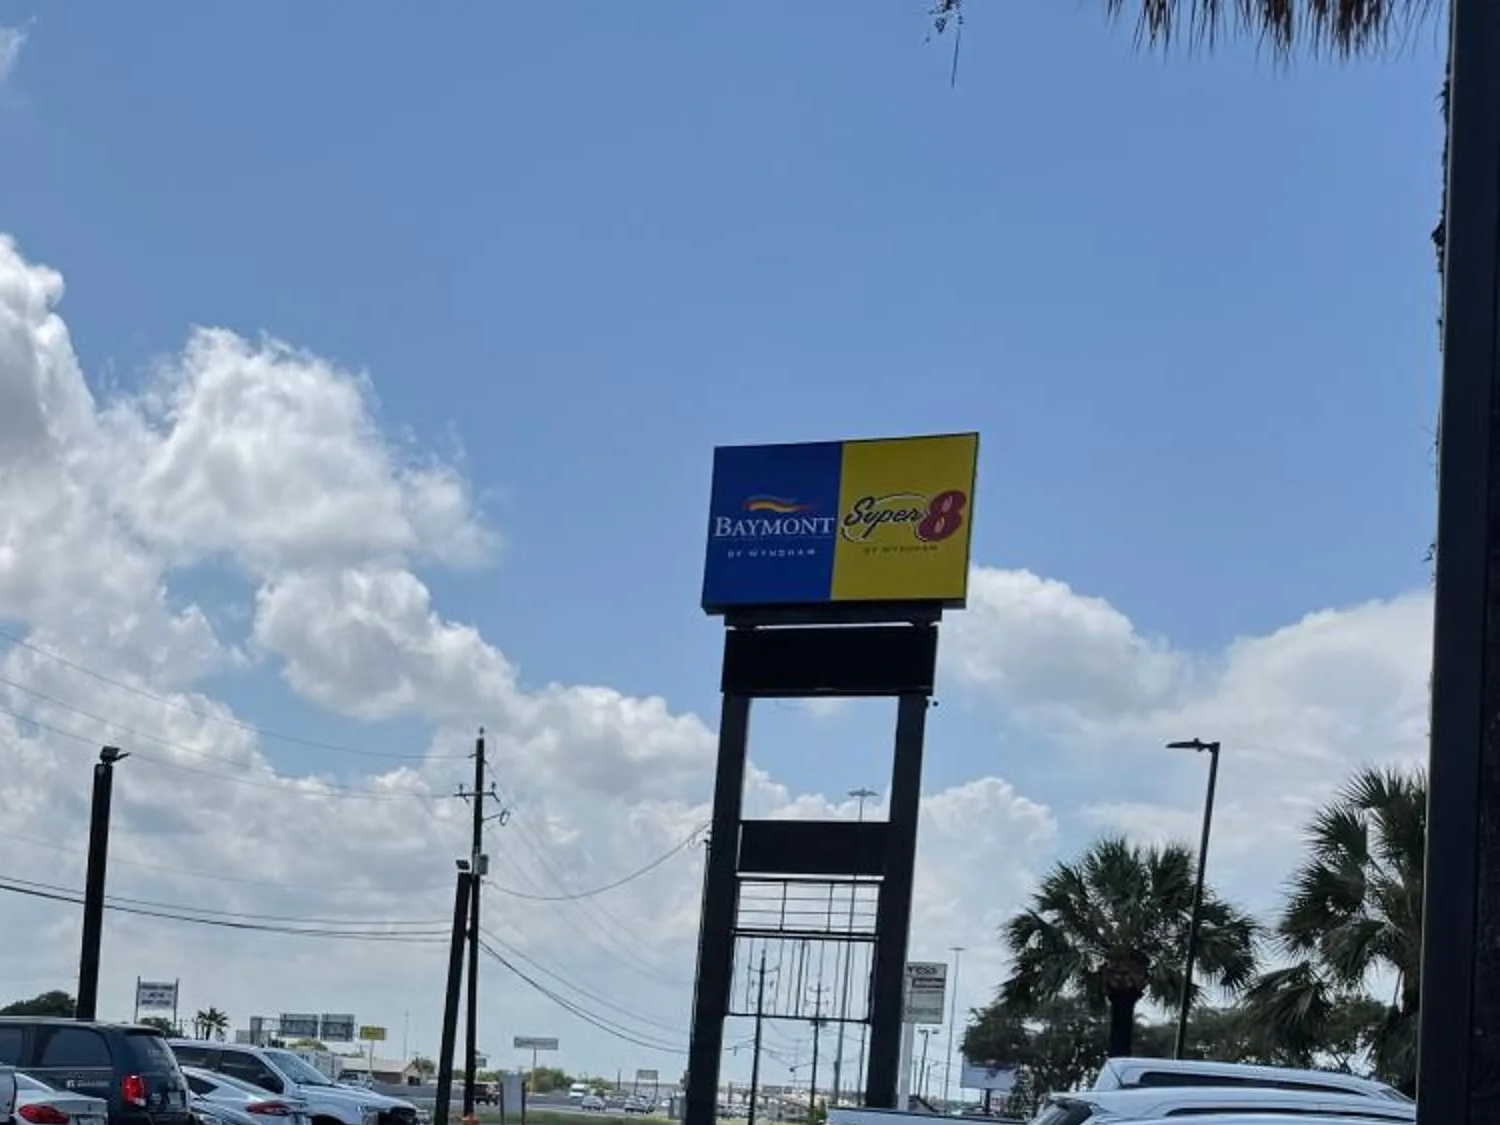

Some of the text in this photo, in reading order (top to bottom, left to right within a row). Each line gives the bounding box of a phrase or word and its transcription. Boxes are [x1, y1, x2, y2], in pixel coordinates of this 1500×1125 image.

[715, 516, 836, 537] BAYMONT
[843, 490, 966, 541] Super 8
